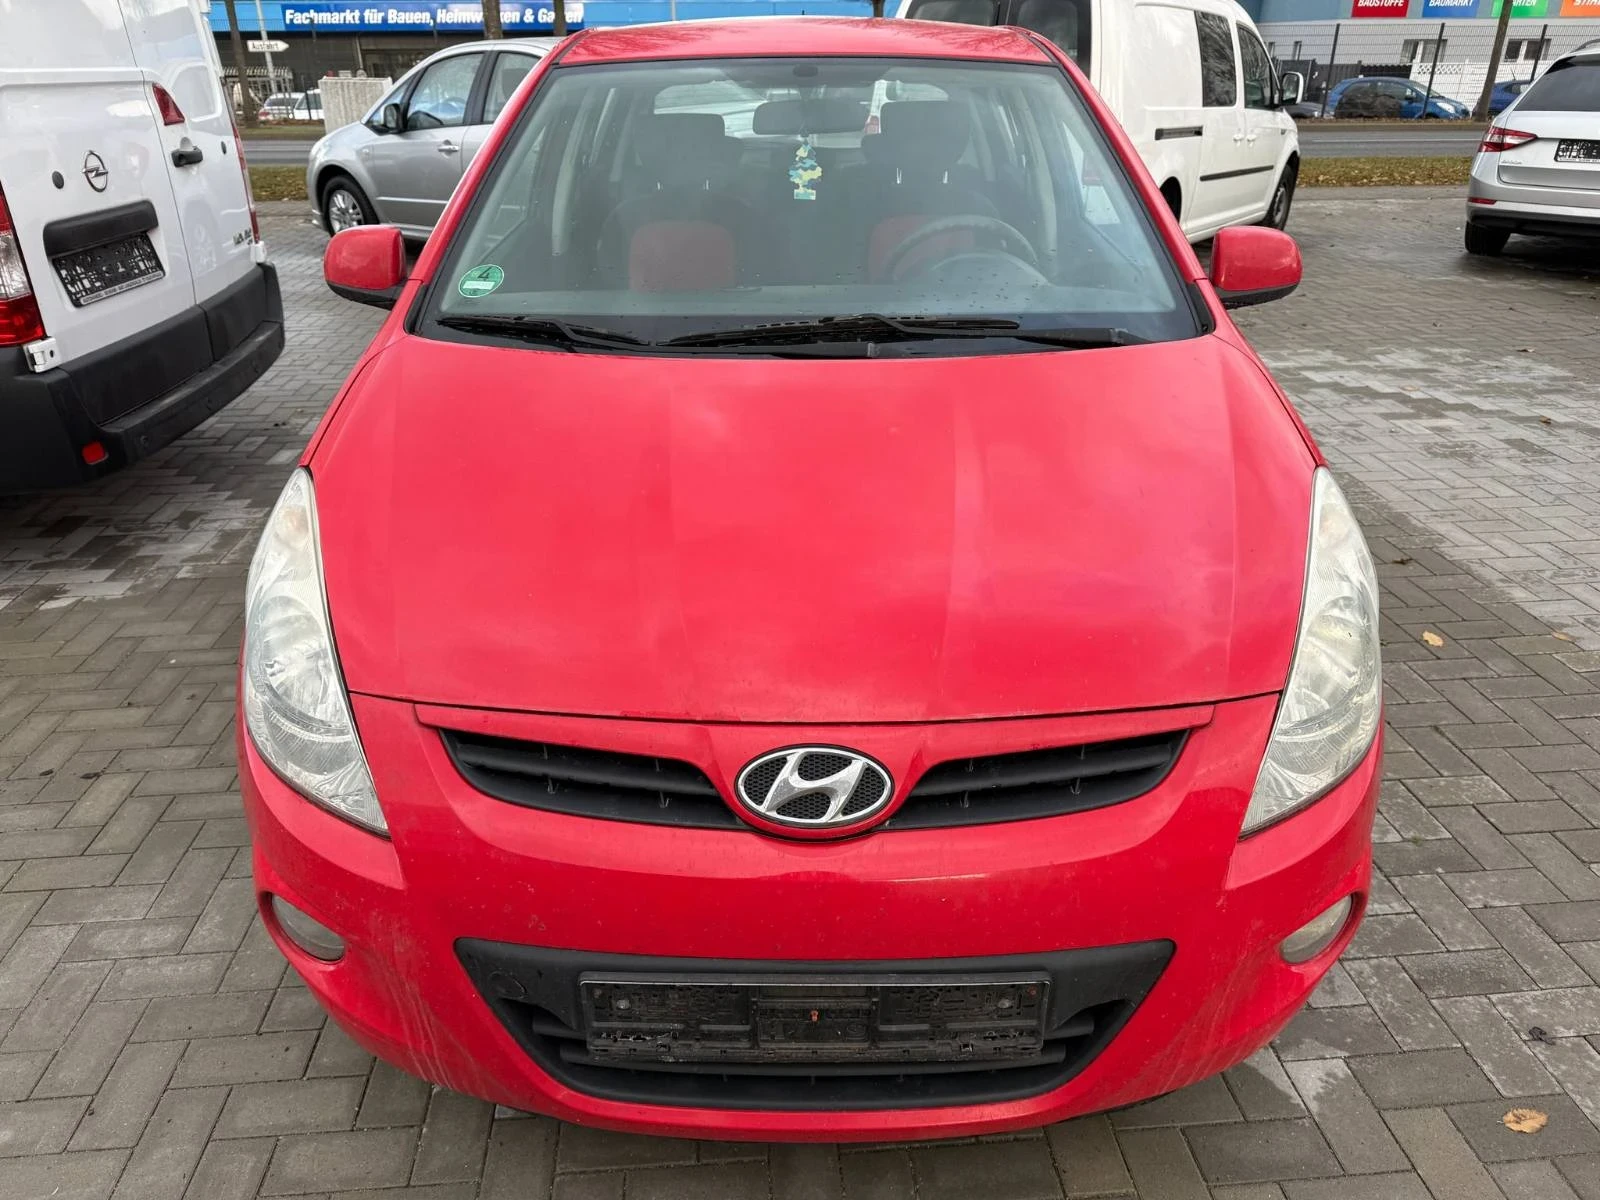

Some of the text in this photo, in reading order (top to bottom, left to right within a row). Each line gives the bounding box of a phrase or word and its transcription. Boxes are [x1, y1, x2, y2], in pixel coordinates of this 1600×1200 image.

[285, 9, 360, 25] Fachmarkt
[363, 9, 385, 24] für
[387, 9, 434, 26] Bauen,
[523, 8, 535, 23] &
[537, 8, 583, 23] Gaen
[477, 266, 492, 282] 4
